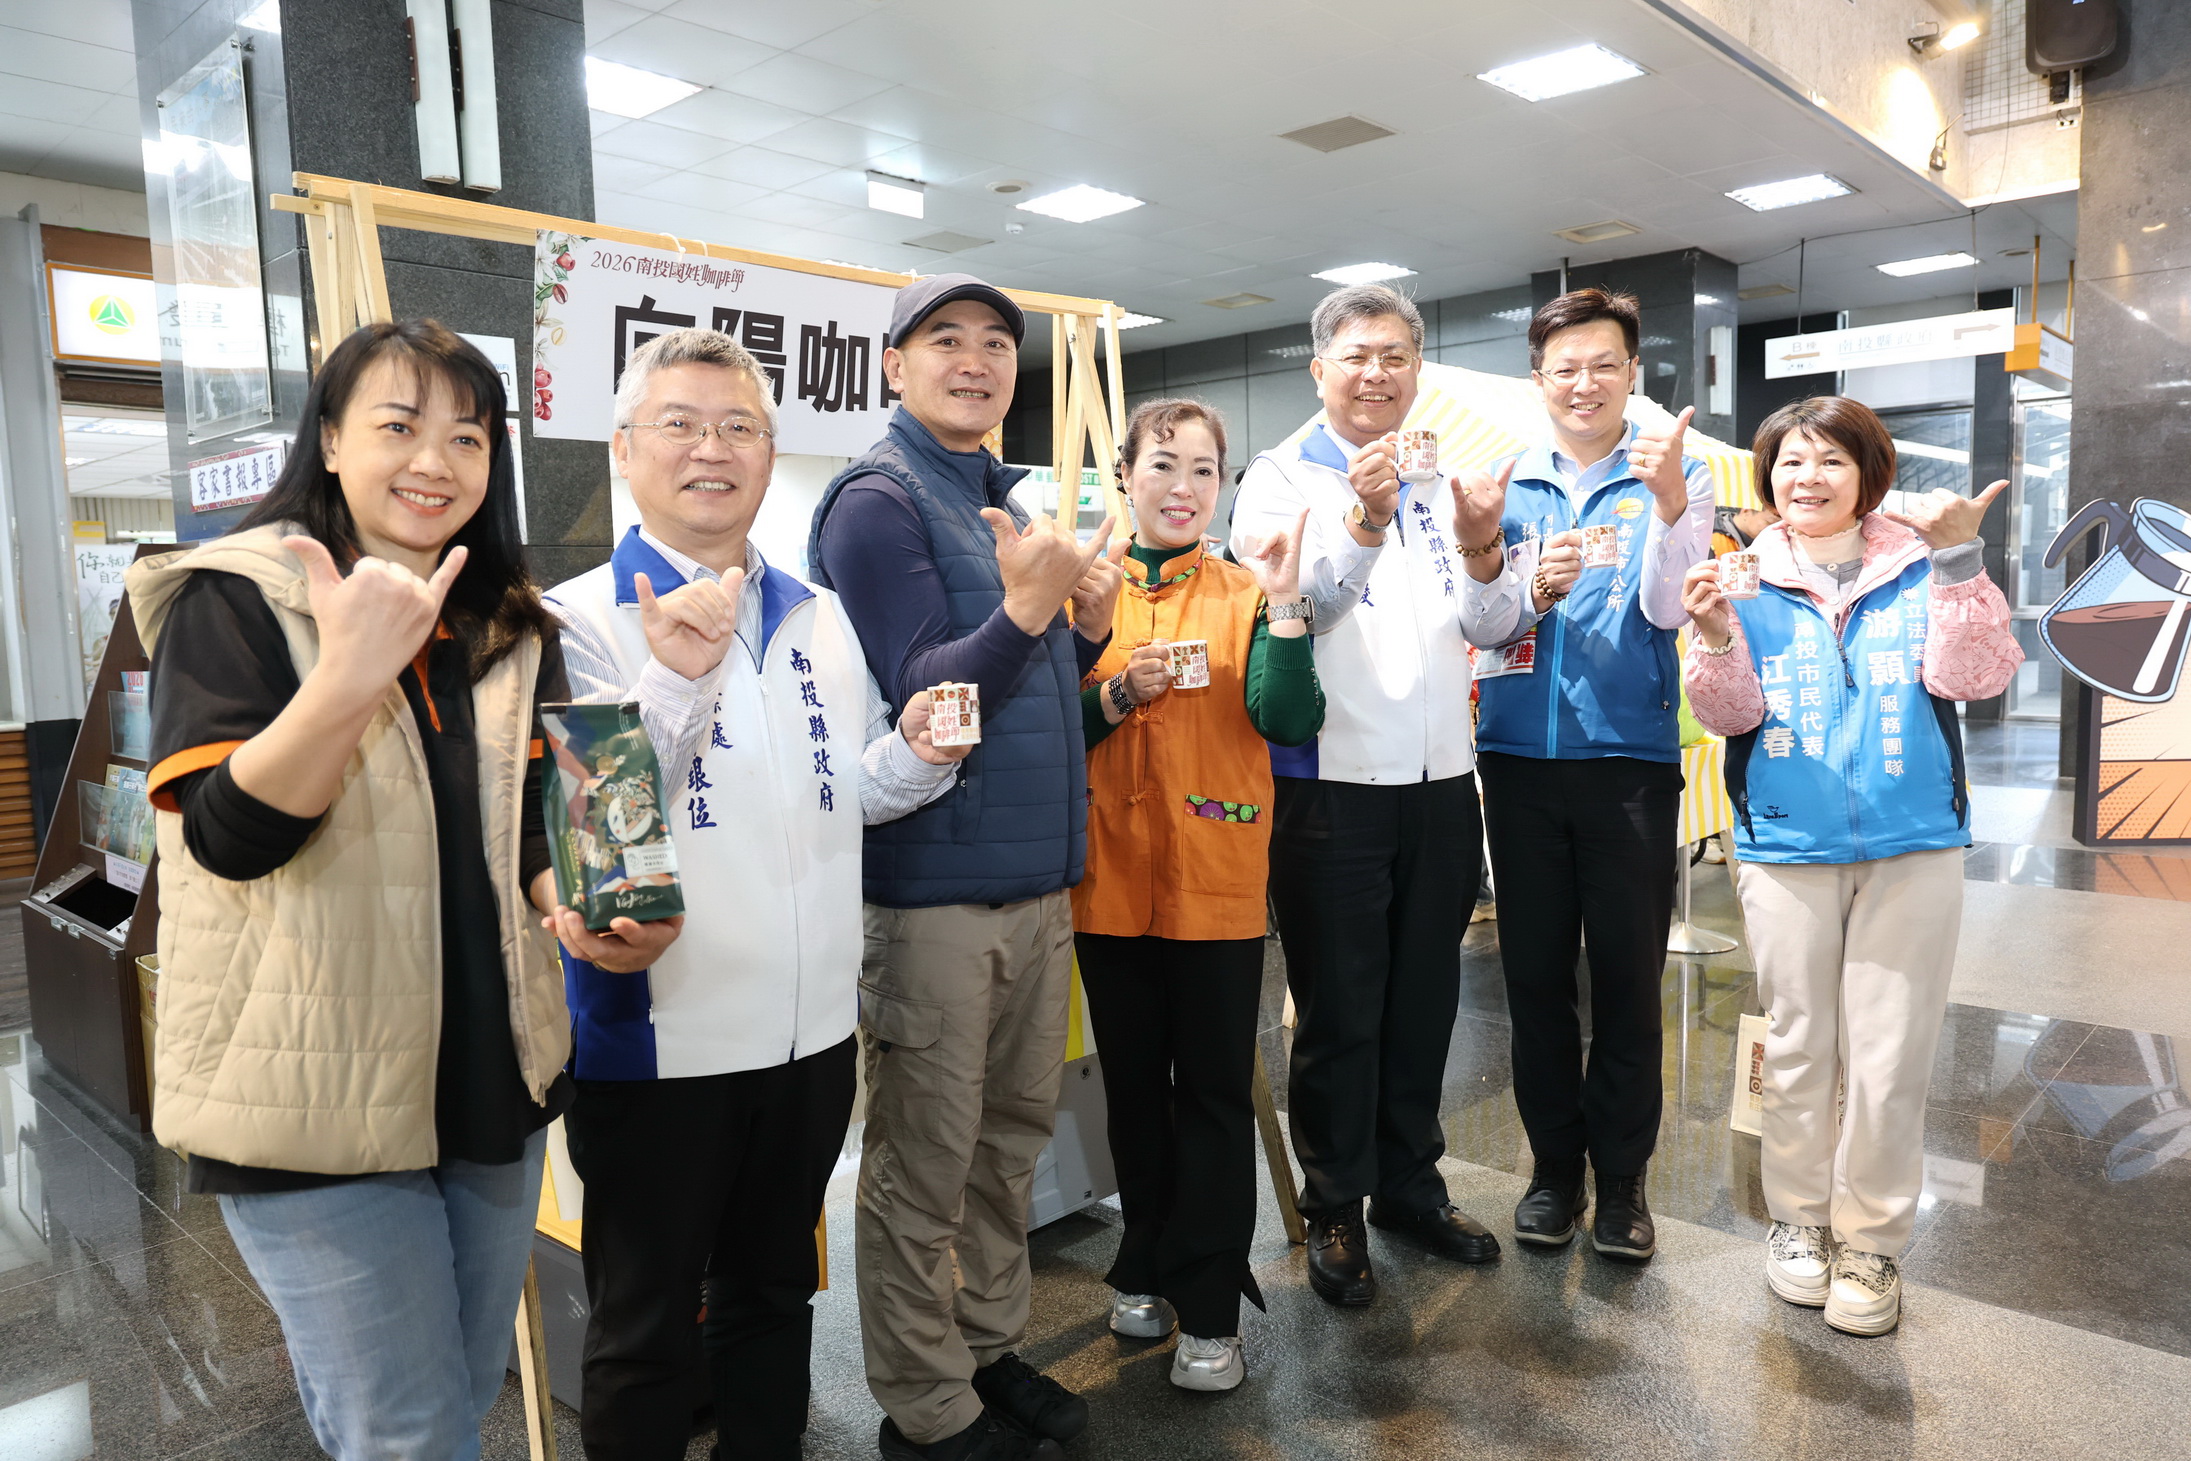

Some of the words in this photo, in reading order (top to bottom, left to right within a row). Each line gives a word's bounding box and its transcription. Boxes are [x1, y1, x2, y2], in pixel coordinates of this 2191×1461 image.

[197, 453, 277, 501] 客家書報專區
[1412, 500, 1454, 598] 南投縣政府
[1606, 523, 1634, 612] 南投市公所
[1863, 607, 1911, 687] 游顥
[1904, 604, 1928, 684] 立法委員
[789, 647, 834, 812] 南投縣政府
[1761, 653, 1796, 759] 江秀春
[1794, 623, 1825, 757] 南投市民代表
[1879, 695, 1904, 776] 服務團隊
